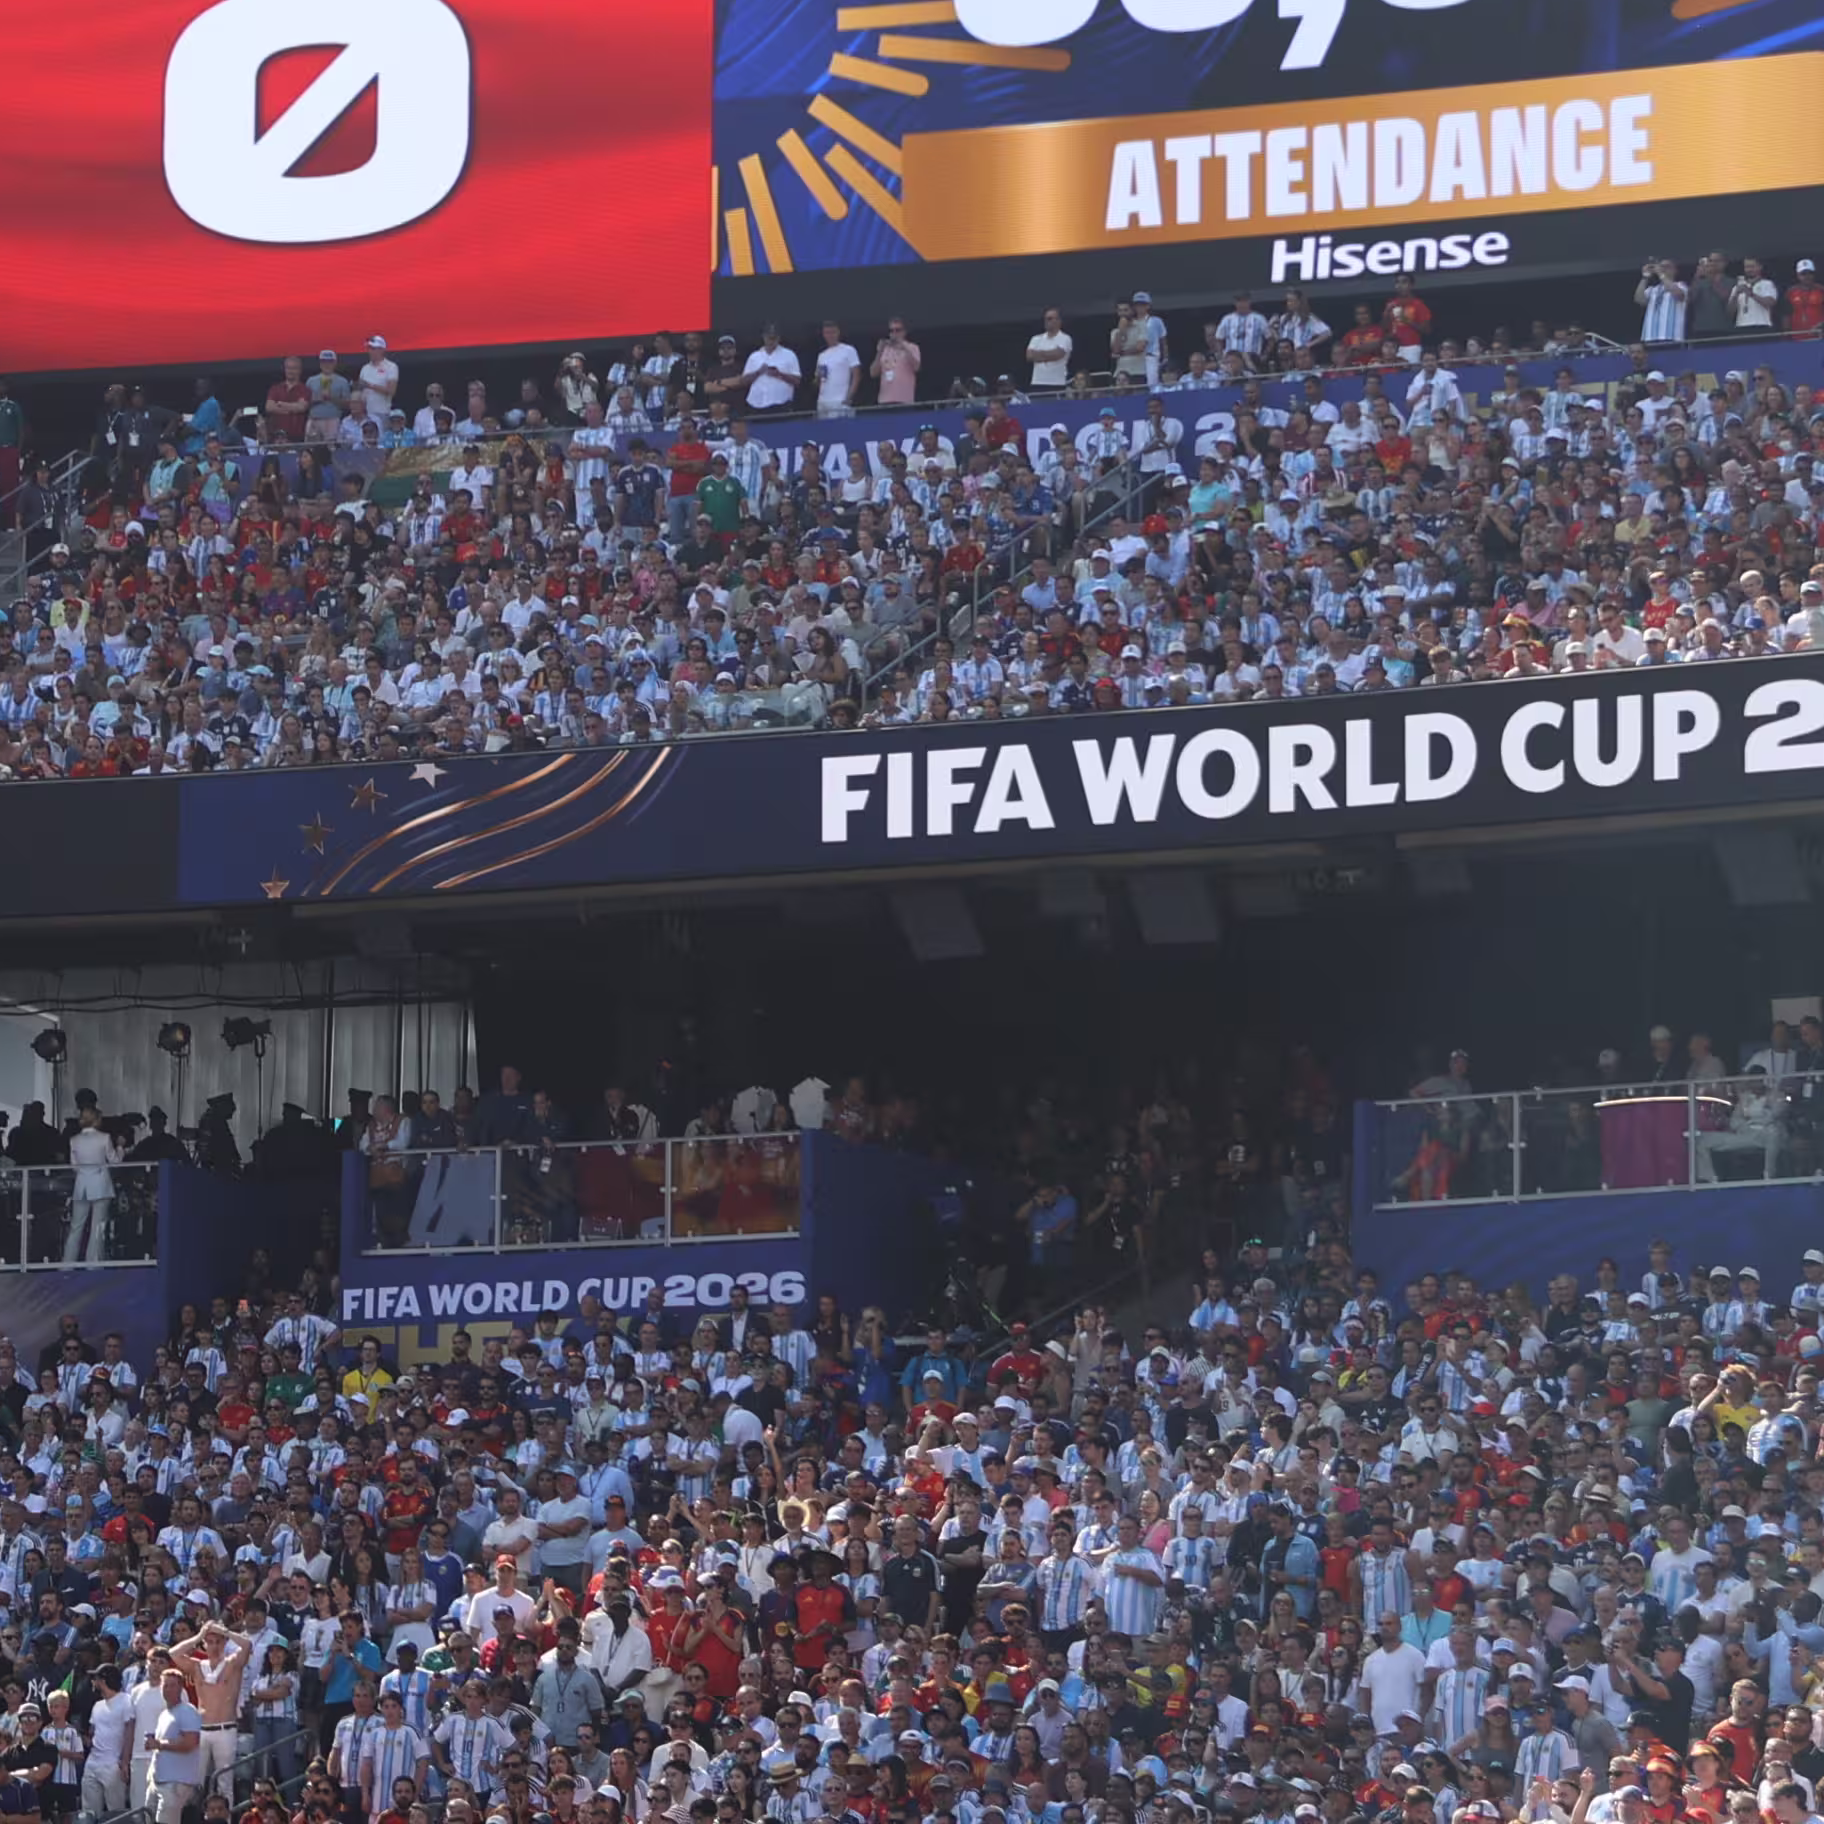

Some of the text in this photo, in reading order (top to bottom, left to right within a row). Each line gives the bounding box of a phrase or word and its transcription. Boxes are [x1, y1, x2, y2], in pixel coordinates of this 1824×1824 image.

[1105, 93, 1653, 229] ATTENDANCE
[1271, 232, 1509, 283] Hisense
[822, 744, 1056, 842] FIFA
[1072, 712, 1478, 825] WORLD
[1500, 690, 1721, 793] CUP
[343, 1270, 806, 1321] FIFA WORLD CUP 2026
